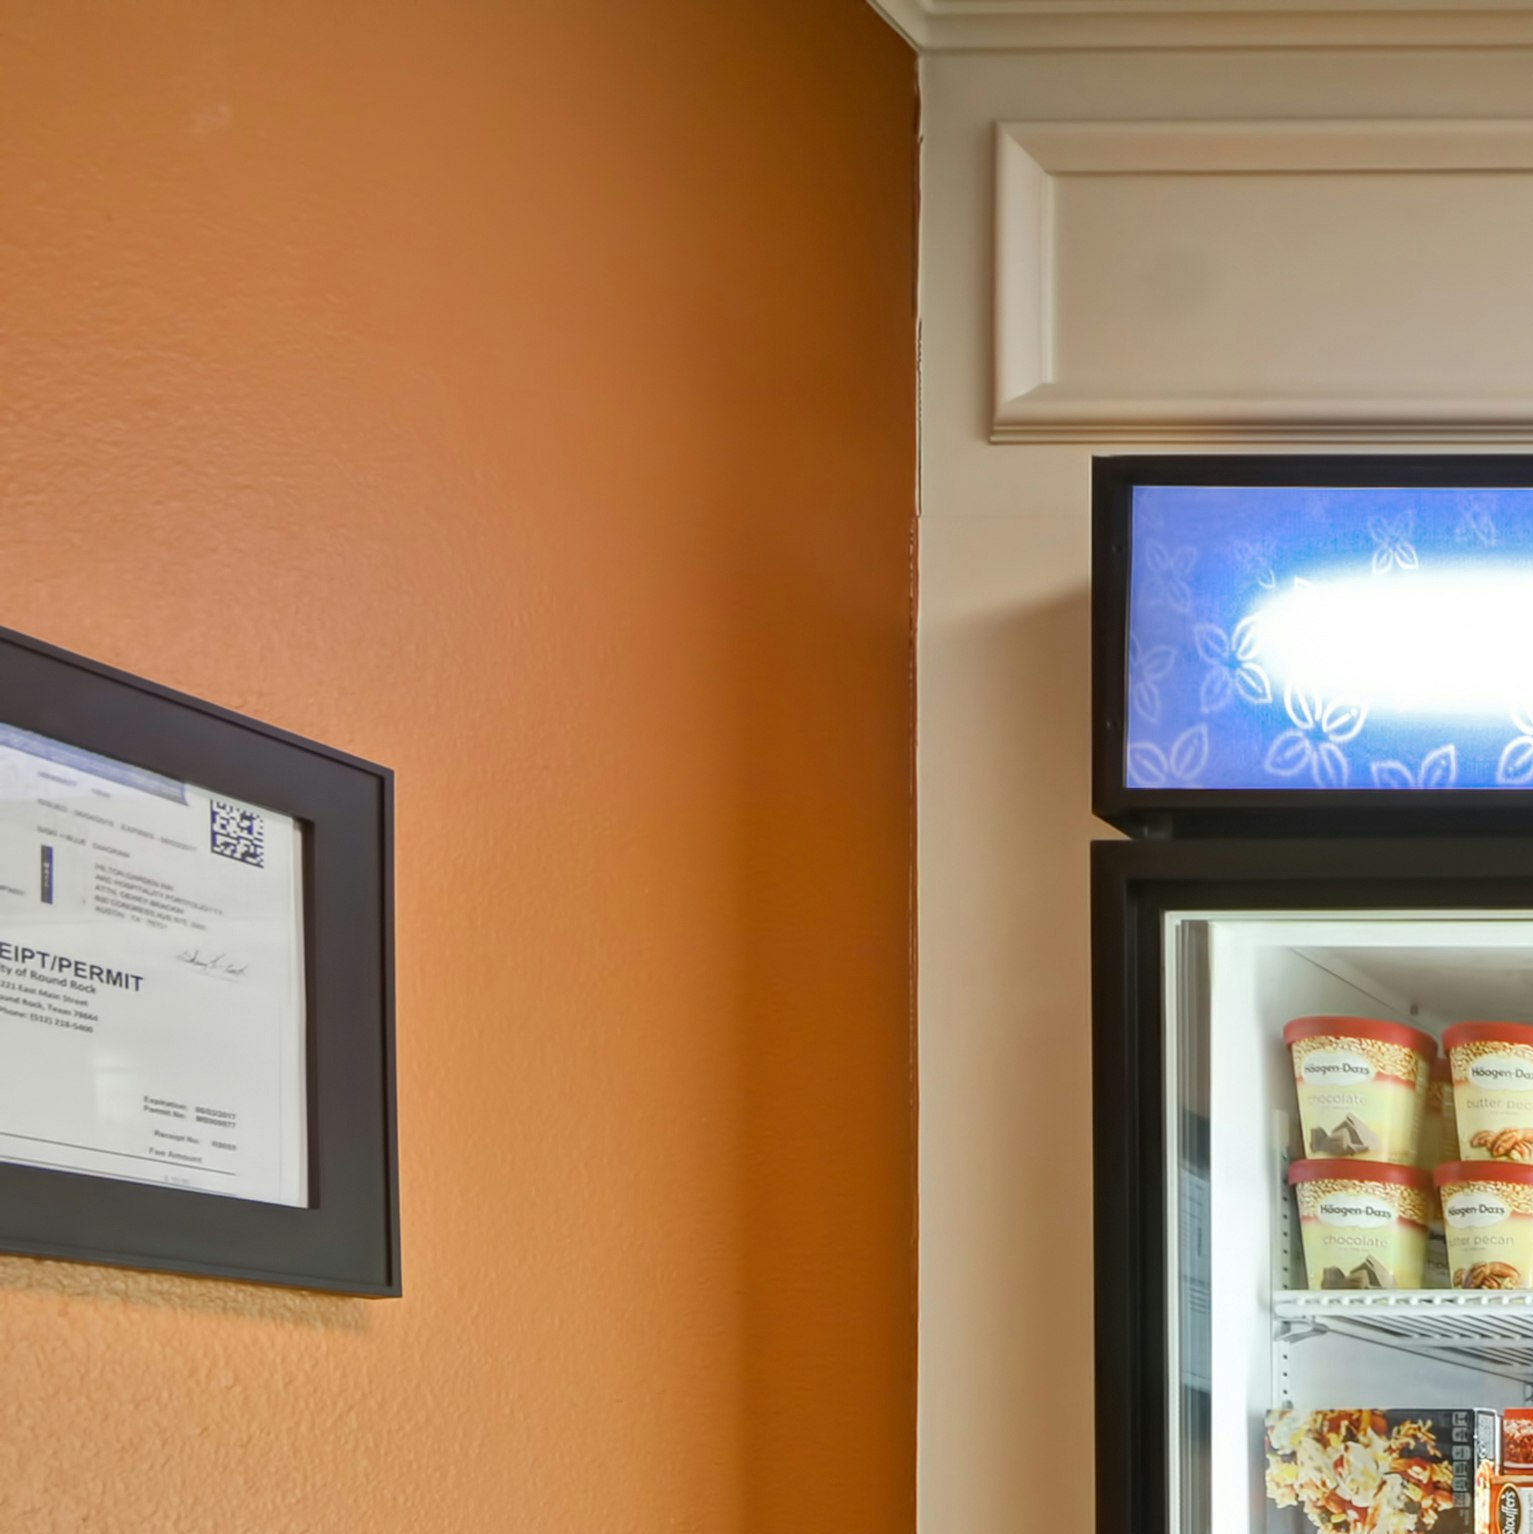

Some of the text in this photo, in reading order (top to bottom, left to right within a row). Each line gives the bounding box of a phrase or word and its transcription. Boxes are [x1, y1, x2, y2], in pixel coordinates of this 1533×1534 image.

[15, 967, 97, 994] of Round Rock
[18, 984, 36, 996] East
[38, 988, 60, 1000] Main
[63, 993, 88, 1007] Street
[48, 1004, 72, 1016] Texas
[1323, 1234, 1388, 1247] chocolate
[1478, 1235, 1514, 1248] pecan
